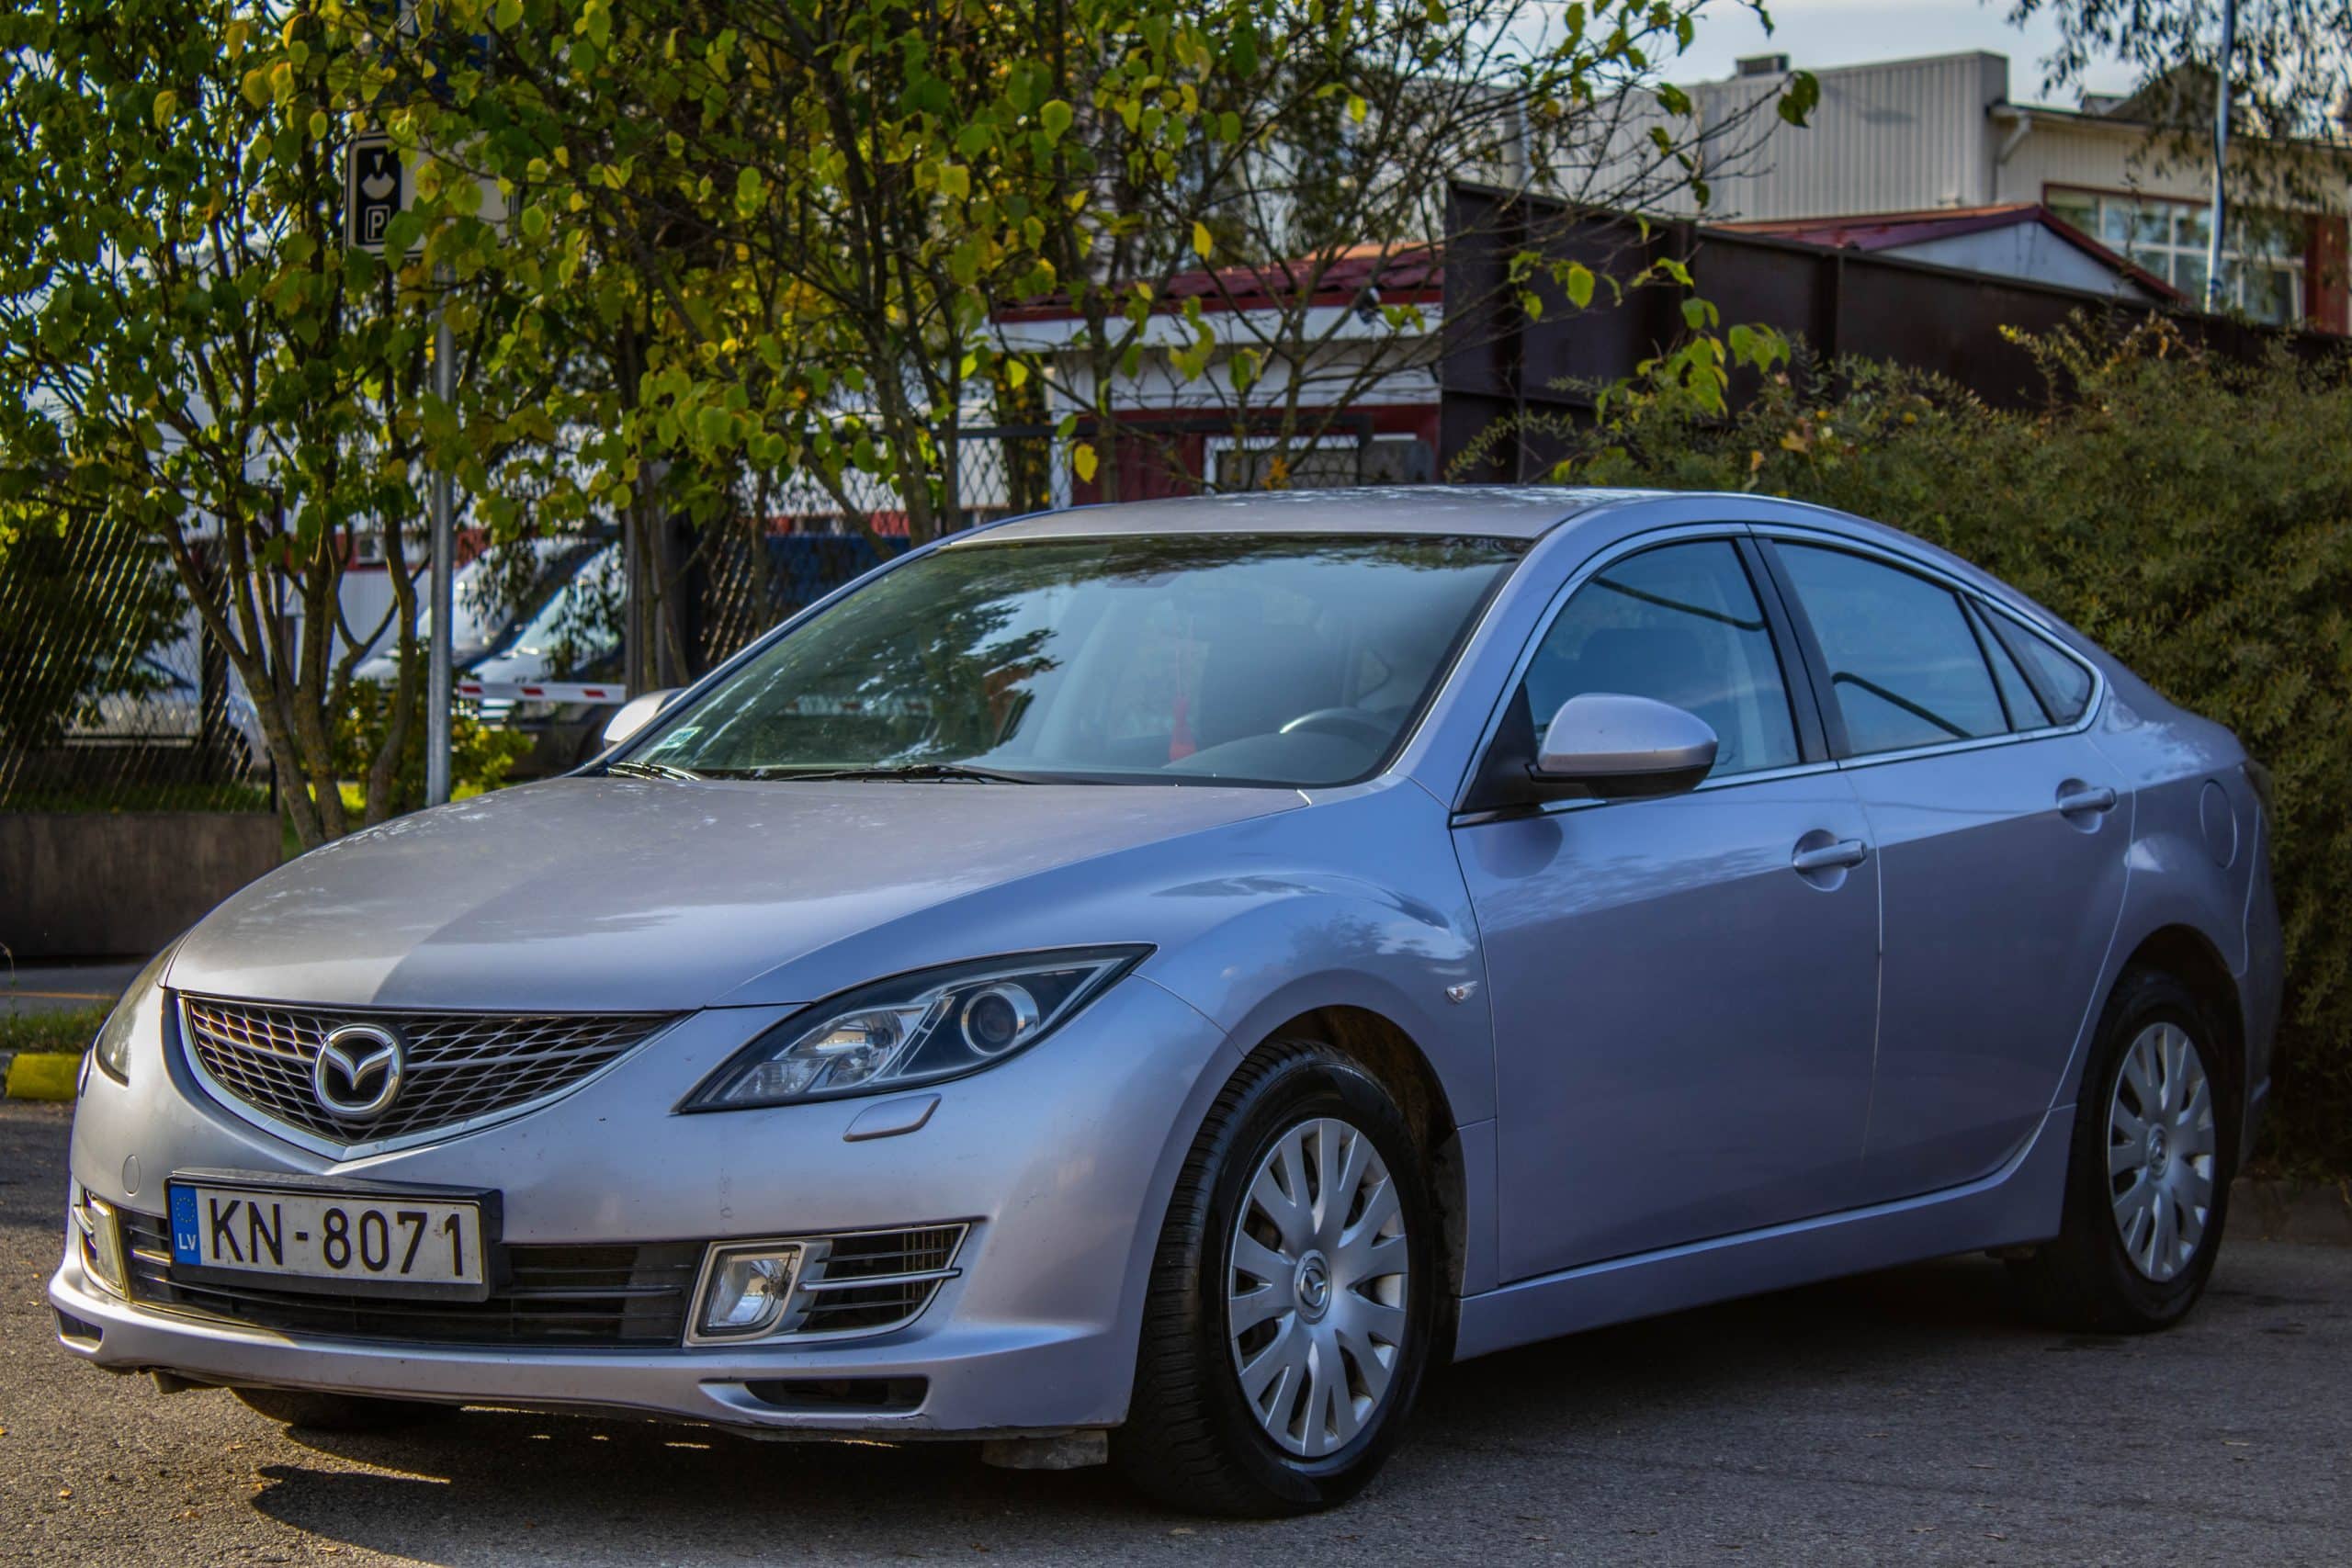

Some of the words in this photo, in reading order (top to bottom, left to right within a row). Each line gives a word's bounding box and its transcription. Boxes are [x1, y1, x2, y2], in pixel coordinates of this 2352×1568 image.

[370, 210, 385, 238] P
[178, 1232, 197, 1251] LV
[209, 1198, 464, 1277] KN-8071
